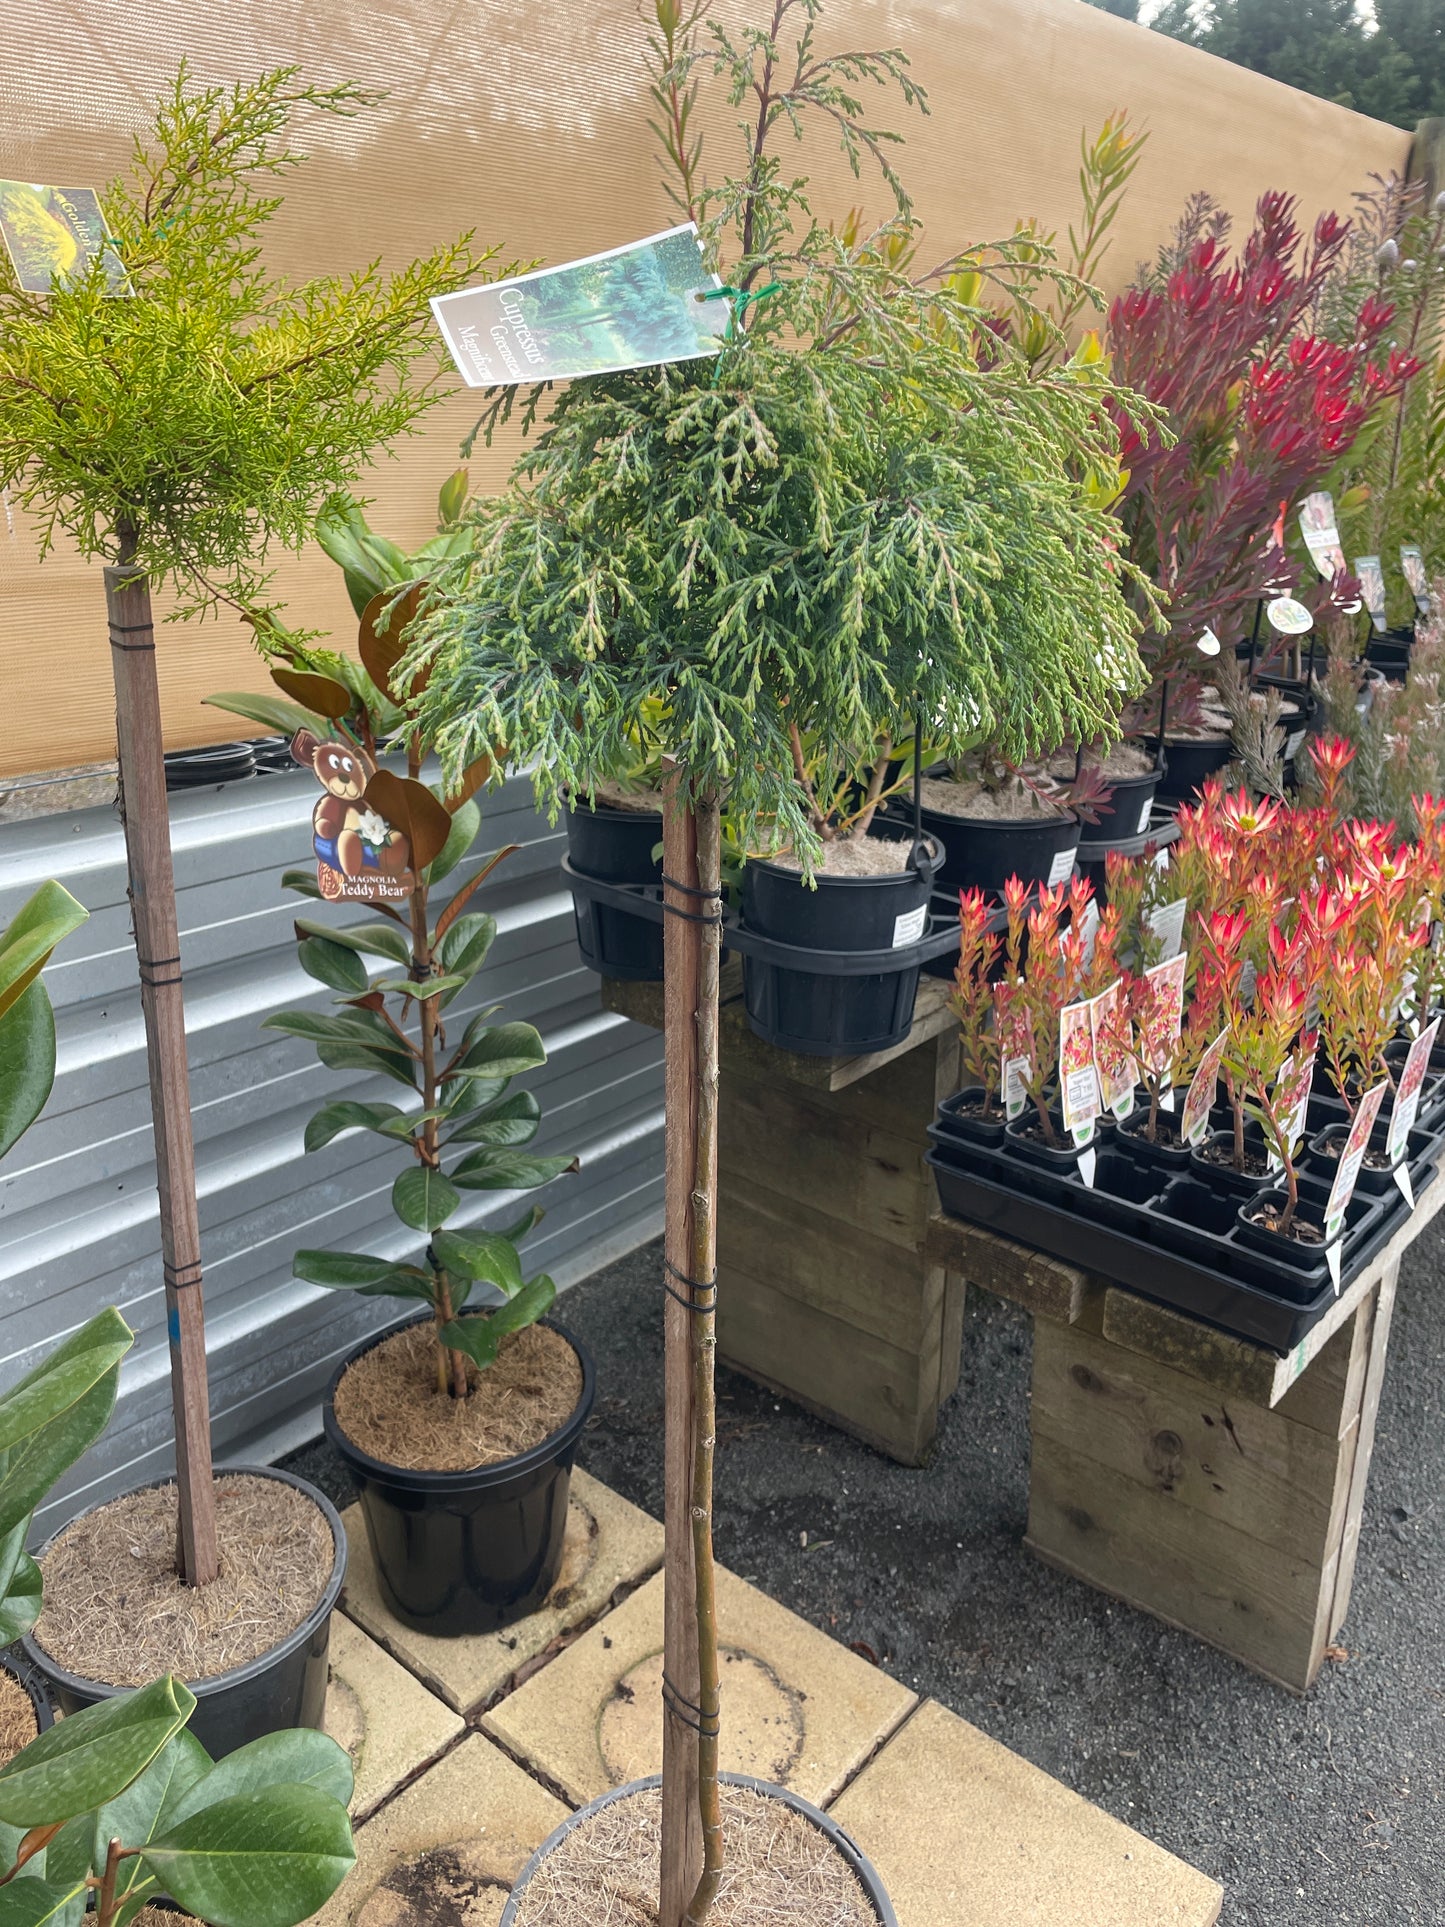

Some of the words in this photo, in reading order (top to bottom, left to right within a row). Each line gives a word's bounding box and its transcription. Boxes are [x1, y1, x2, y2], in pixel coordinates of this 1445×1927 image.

[61, 202, 92, 247] Golden
[499, 287, 545, 364] Cupressus
[490, 324, 532, 379] Greenstead
[341, 882, 375, 900] Teddy
[347, 875, 398, 884] MAGNOLIA
